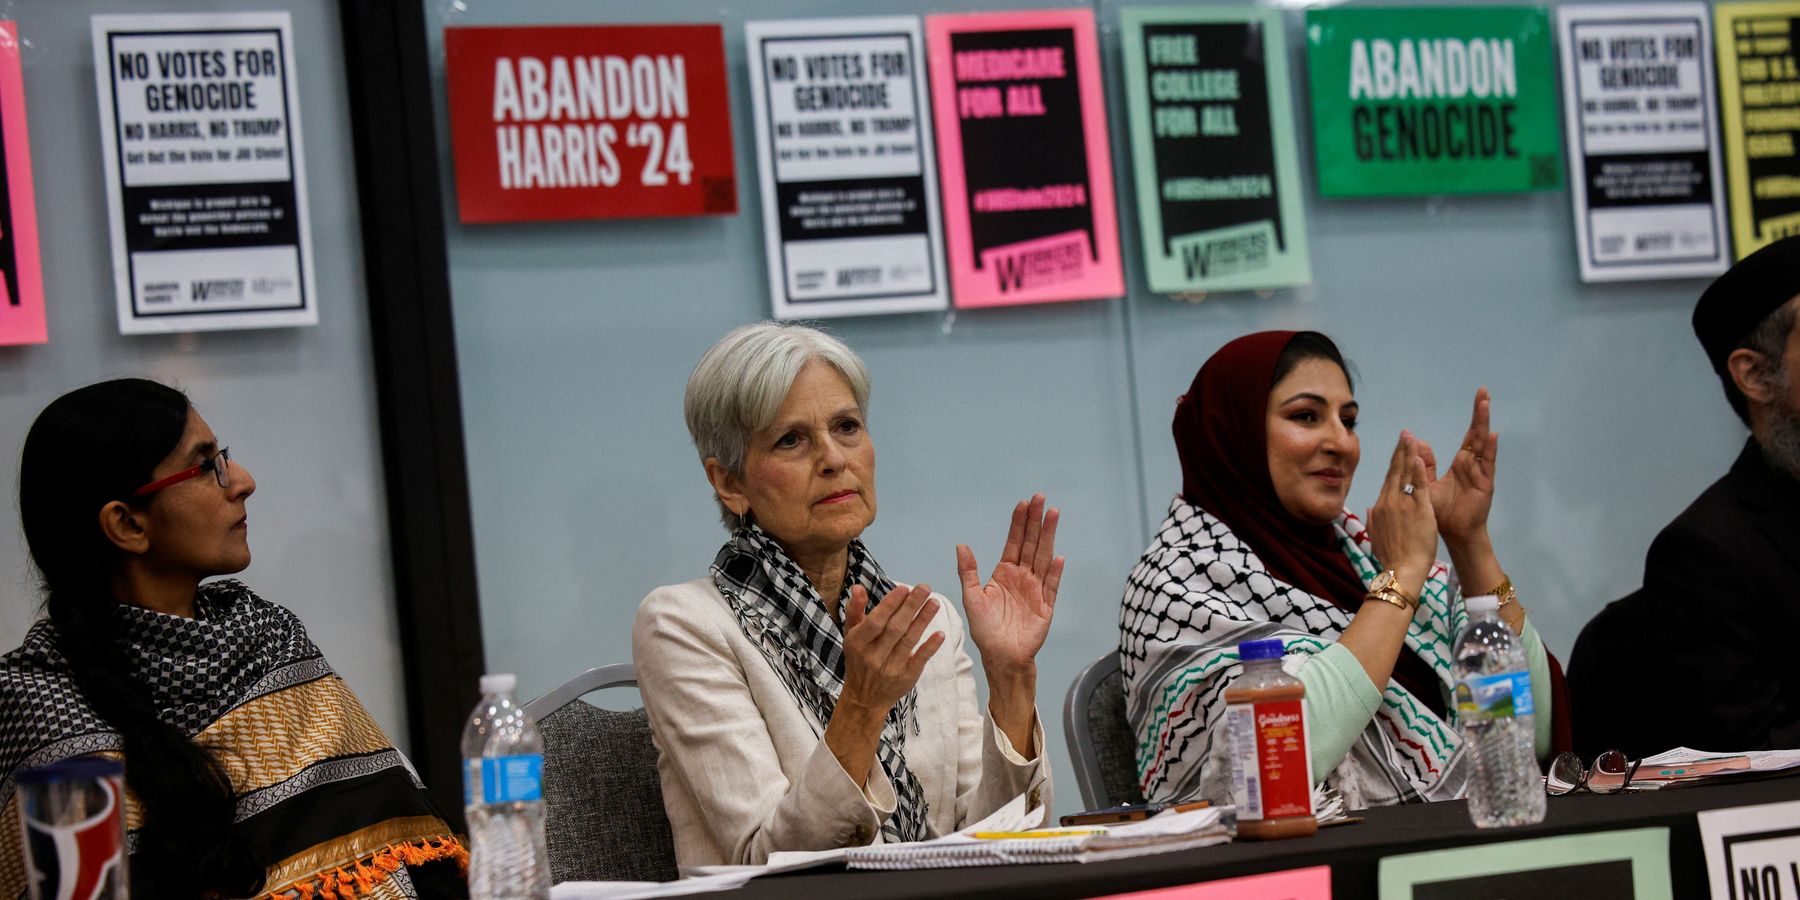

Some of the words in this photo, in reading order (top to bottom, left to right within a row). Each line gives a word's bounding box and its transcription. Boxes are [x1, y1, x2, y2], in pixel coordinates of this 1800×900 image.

[1149, 34, 1199, 66] FREE
[1582, 39, 1602, 60] NO
[1609, 37, 1658, 60] VOTES
[1664, 35, 1694, 58] FOR
[119, 52, 149, 80] NO
[157, 50, 226, 78] VOTES
[235, 49, 276, 77] FOR
[772, 57, 797, 81] NO
[803, 54, 864, 79] VOTES
[870, 53, 905, 77] FOR
[956, 47, 1067, 81] MEDICARE
[1349, 38, 1517, 99] ABANDON
[1601, 64, 1680, 89] GENOCIDE
[145, 82, 256, 112] GENOCIDE
[492, 54, 689, 122] ABANDON
[795, 84, 889, 111] GENOCIDE
[1151, 69, 1241, 101] COLLEGE
[959, 87, 1004, 119] FOR
[1006, 84, 1047, 117] ALL
[125, 123, 143, 140] NO
[148, 121, 205, 140] HARRIS,
[209, 121, 228, 138] NO
[233, 119, 281, 137] TRUMP
[1155, 106, 1198, 138] FOR
[1201, 105, 1241, 136] ALL
[1353, 103, 1520, 163] GENOCIDE
[496, 122, 622, 189] HARRIS
[1741, 865, 1781, 900] NO
